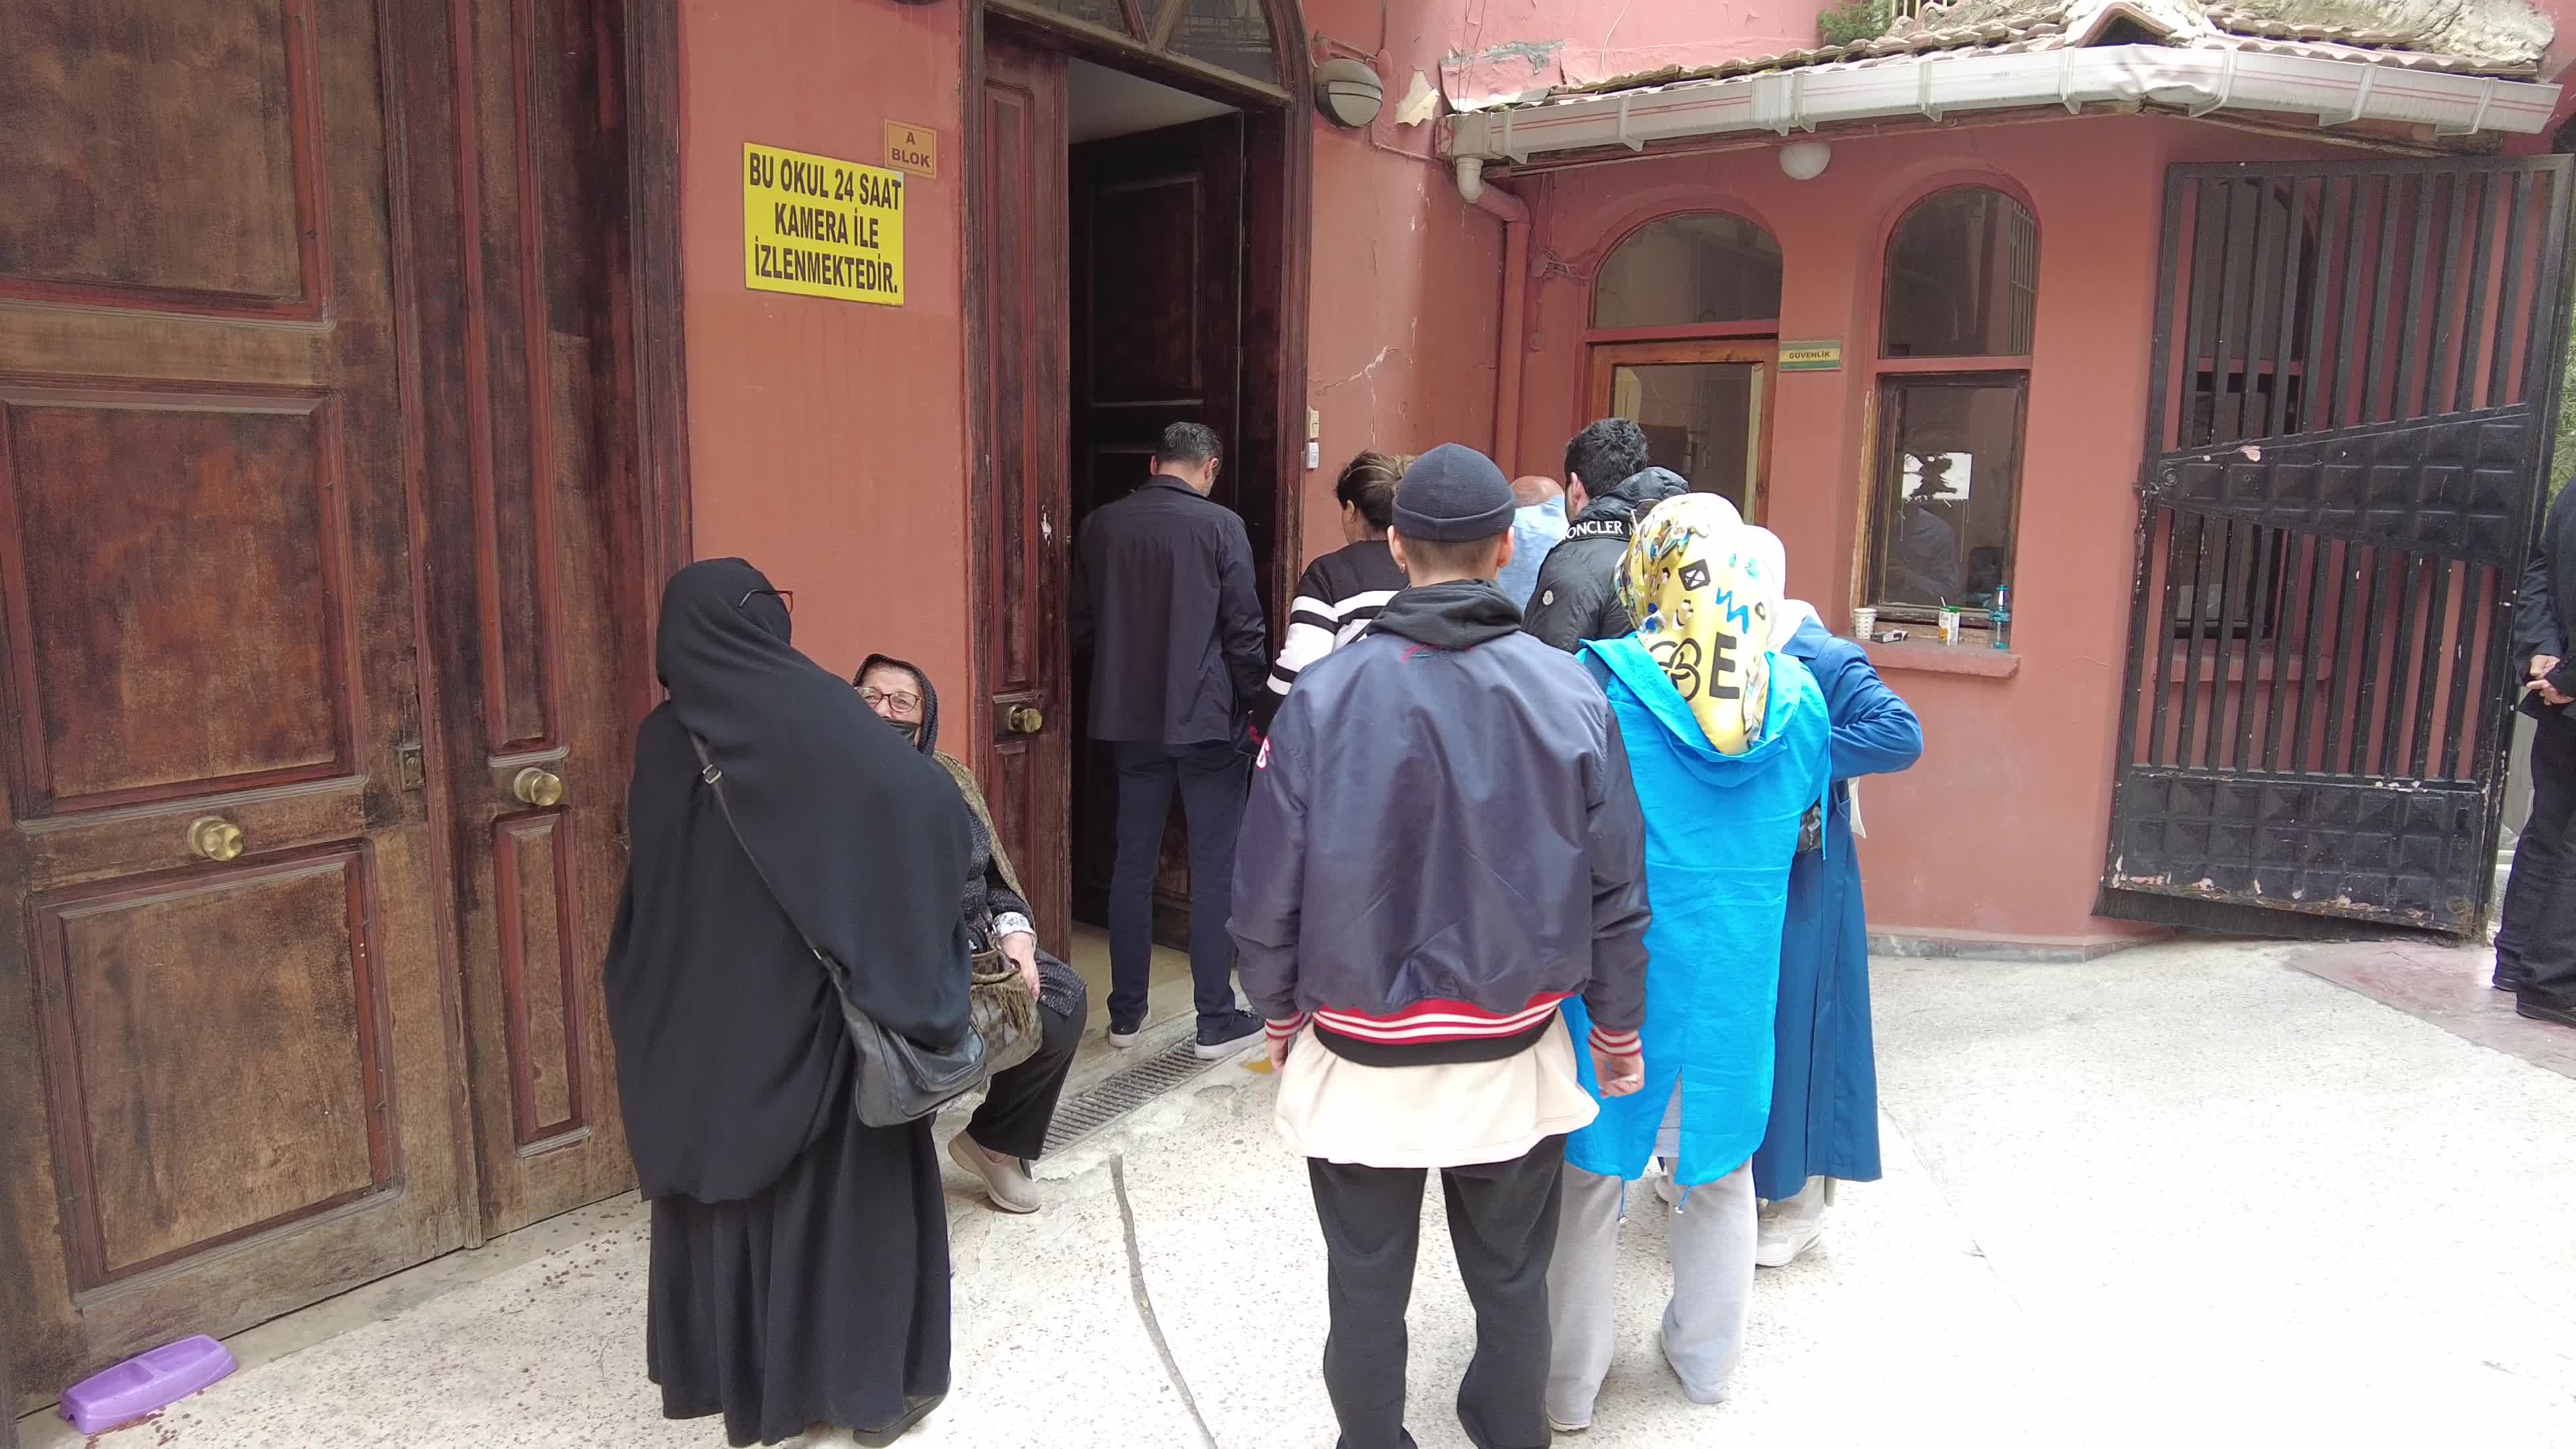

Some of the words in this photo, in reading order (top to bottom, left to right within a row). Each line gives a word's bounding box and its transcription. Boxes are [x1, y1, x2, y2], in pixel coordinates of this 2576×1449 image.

[906, 132, 916, 145] A
[892, 148, 930, 168] BLOK
[749, 152, 774, 189] BU
[780, 158, 829, 199] OKUL
[834, 168, 854, 203] 24
[859, 172, 902, 211] SAAT
[775, 202, 849, 245] KAMERA
[854, 207, 879, 250] İLE
[755, 235, 898, 294] İZLENMEKTEDİR.
[1565, 520, 1623, 539] ONCLER
